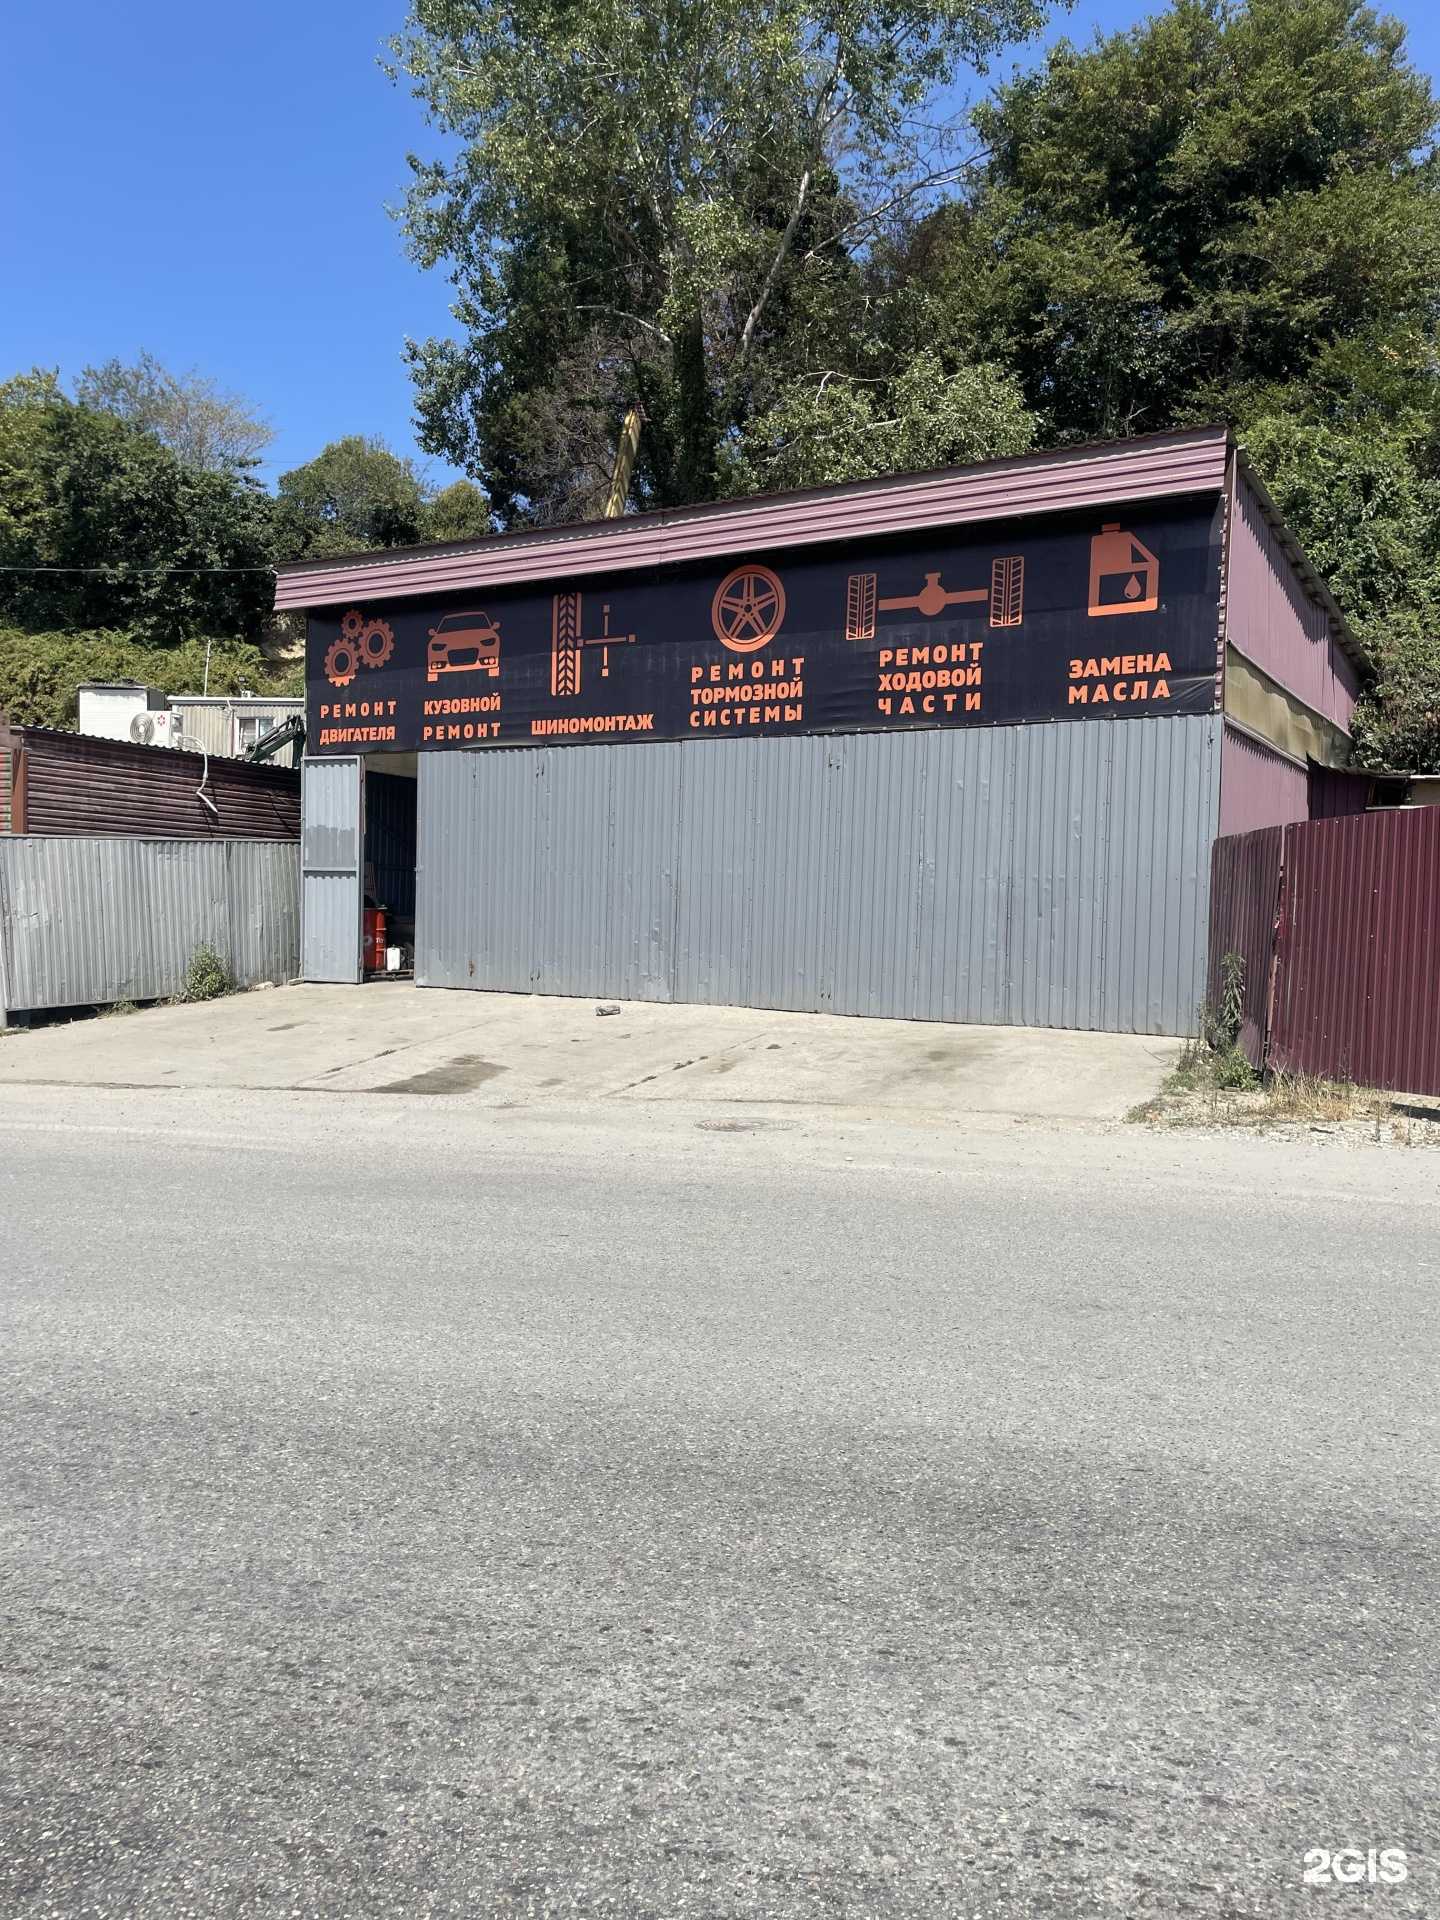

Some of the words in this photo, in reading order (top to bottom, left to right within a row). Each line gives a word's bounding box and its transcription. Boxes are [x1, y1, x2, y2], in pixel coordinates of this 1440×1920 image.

[878, 641, 984, 668] РЕМОНТ
[1068, 651, 1172, 680] ЗАМЕНА
[690, 657, 805, 683] РЕМОНТ
[878, 663, 983, 693] ХОДОВОЙ
[423, 691, 501, 716] КУЗОВНОЙ
[690, 676, 804, 706] ТОРМОЗНОЙ
[1068, 680, 1170, 705] МАСЛА
[319, 700, 397, 719] РЕМОНТ
[689, 704, 803, 728] СИСТЕМЫ
[878, 692, 982, 716] ЧАСТИ
[319, 724, 396, 746] ДВИГАТЕЛЯ
[423, 722, 501, 741] РЕМОНТ
[530, 713, 655, 736] ШИНОМОНТАЖ
